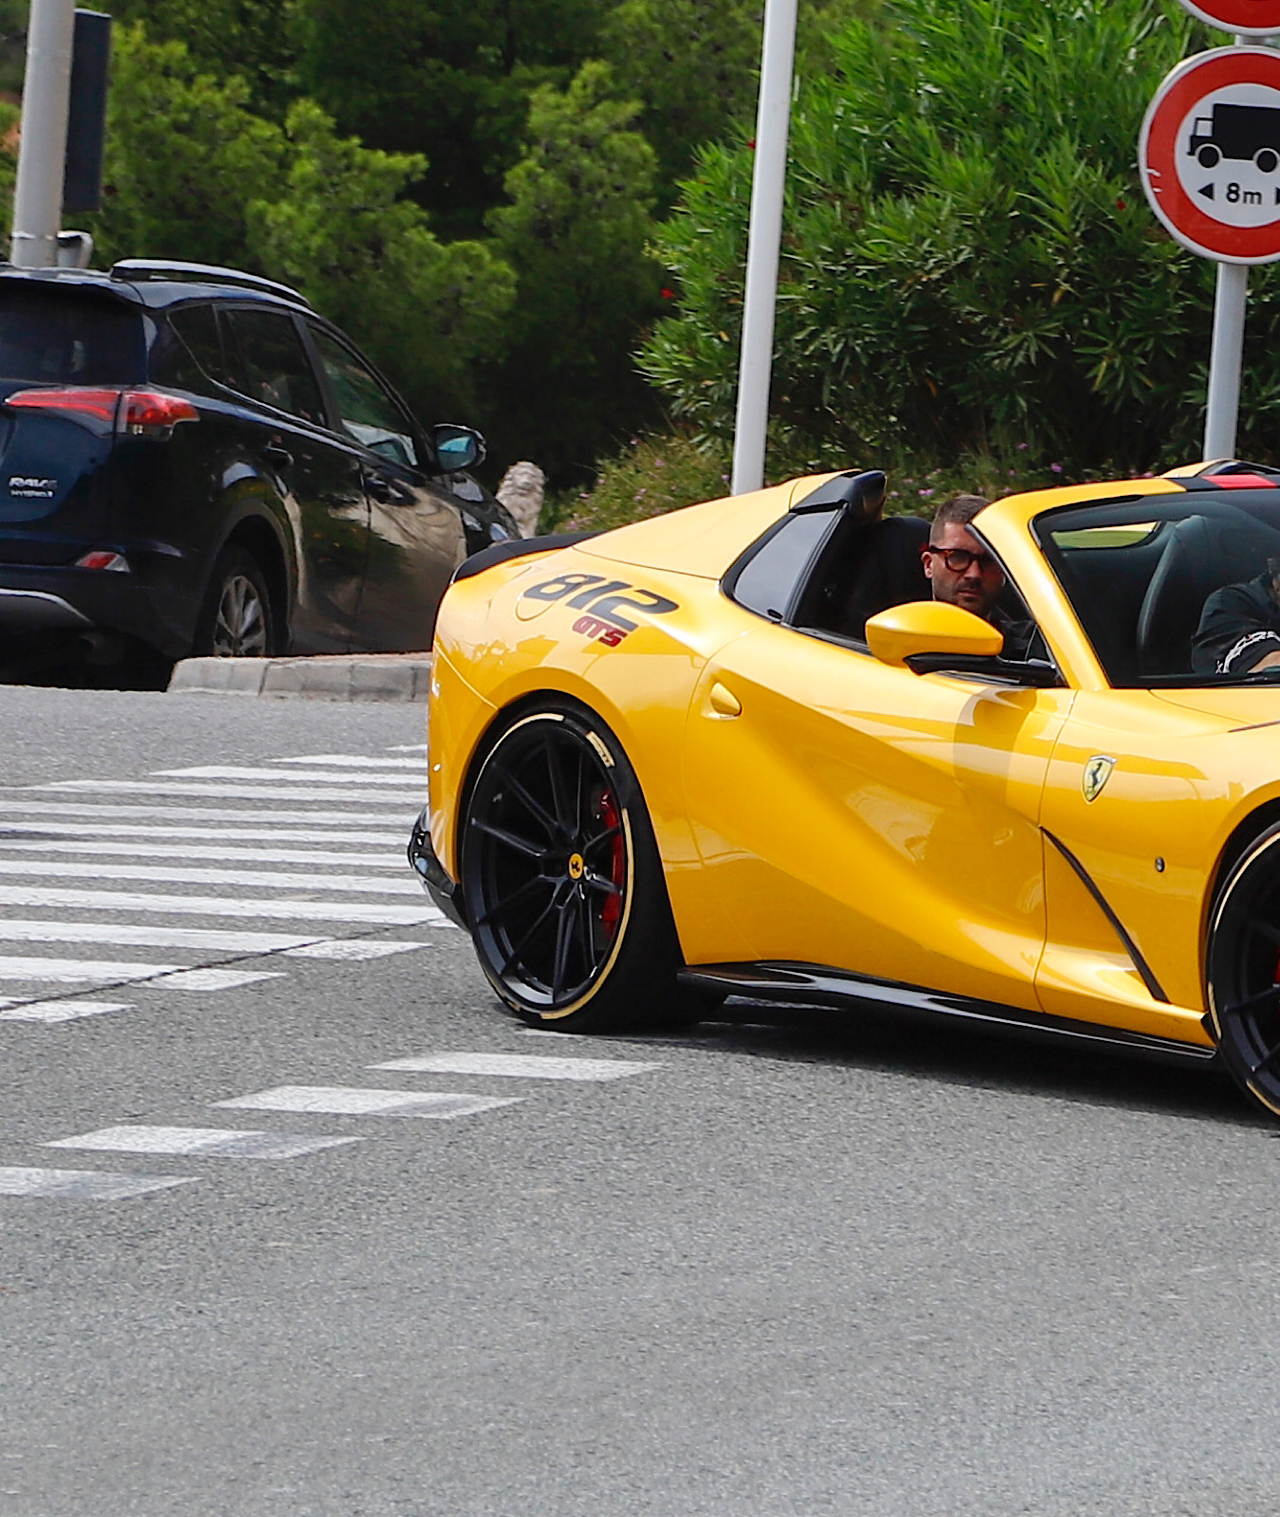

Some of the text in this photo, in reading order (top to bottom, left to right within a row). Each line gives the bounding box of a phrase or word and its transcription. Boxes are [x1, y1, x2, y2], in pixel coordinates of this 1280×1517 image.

[1226, 182, 1262, 205] 8m
[523, 573, 680, 632] 812
[572, 615, 628, 647] GTS
